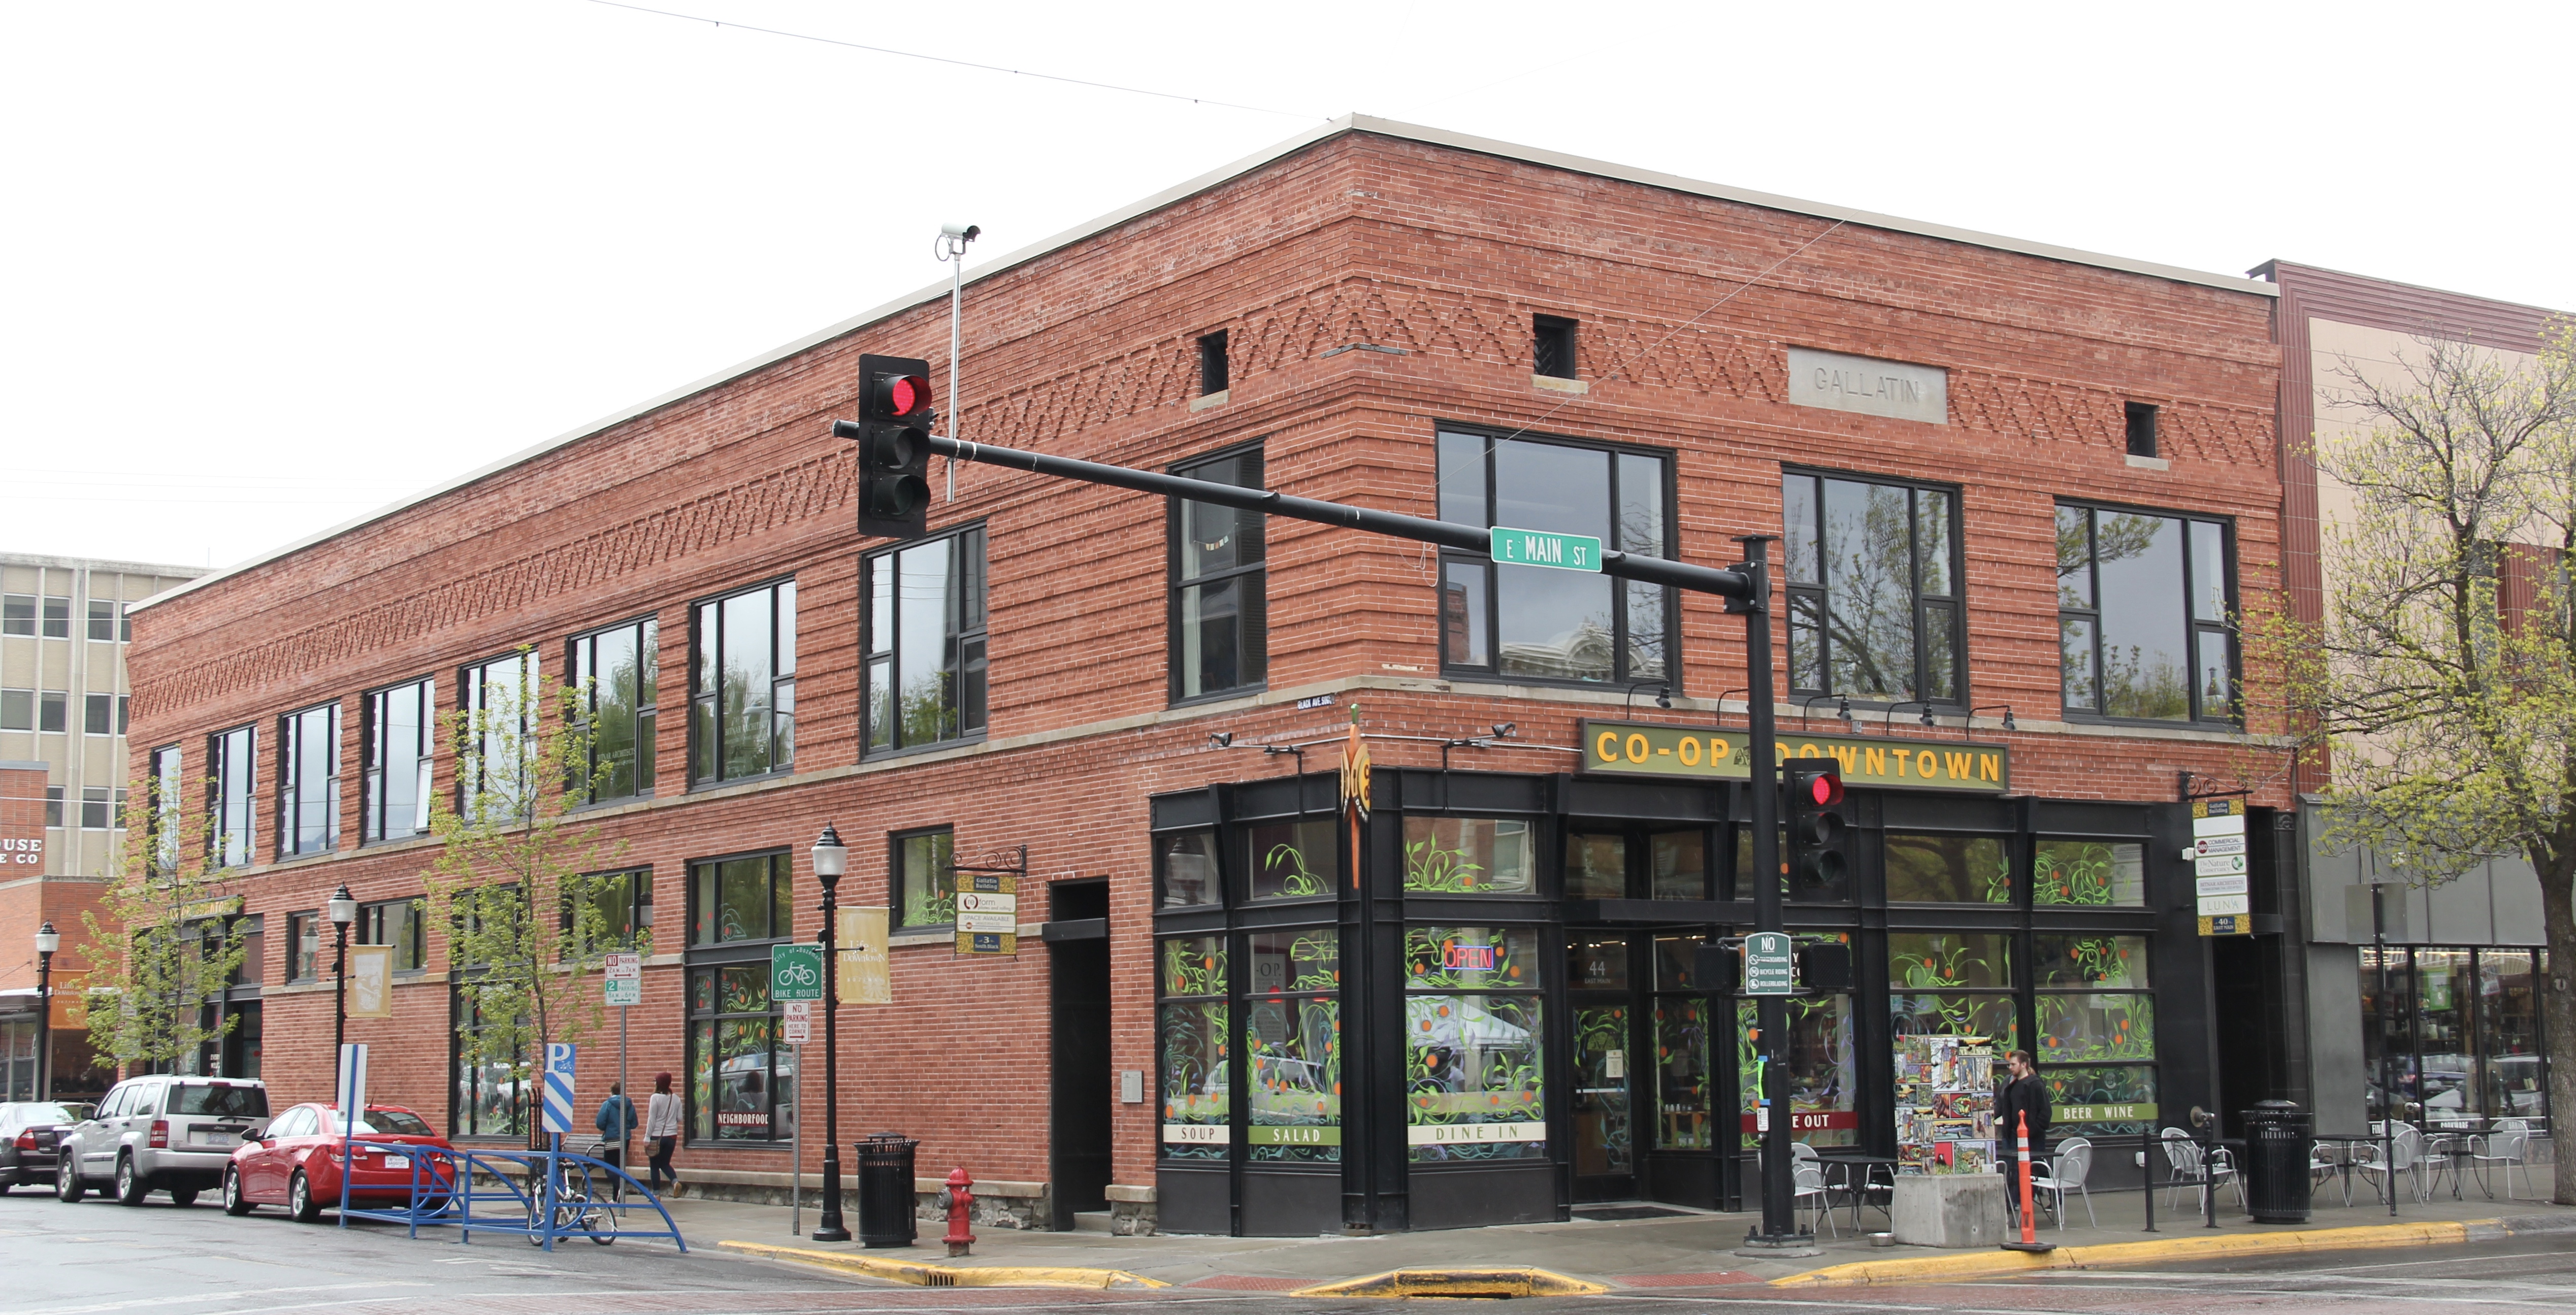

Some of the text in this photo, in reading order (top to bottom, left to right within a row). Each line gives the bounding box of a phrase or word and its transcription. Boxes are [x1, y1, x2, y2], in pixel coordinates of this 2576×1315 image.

[1814, 367, 1918, 404] GALLATIN
[1507, 535, 1586, 566] E MAIN ST
[1596, 731, 1729, 767] CO-OP
[0, 839, 42, 851] USE
[2208, 859, 2230, 867] Nature
[2207, 899, 2239, 911] LUNA
[1762, 937, 1775, 950] NO
[608, 956, 616, 965] NO
[774, 952, 786, 962] City
[1445, 947, 1491, 968] OPEN
[1589, 961, 1605, 975] 44
[609, 981, 615, 990] 2
[775, 989, 819, 998] BIKE ROUTE
[545, 1043, 571, 1073] P
[2063, 1106, 2133, 1119] BEER WINE
[1804, 1114, 1829, 1128] OUT
[1181, 1127, 1215, 1140] SOUP
[1273, 1128, 1320, 1142] SALAD
[1436, 1125, 1517, 1140] DINE IN
